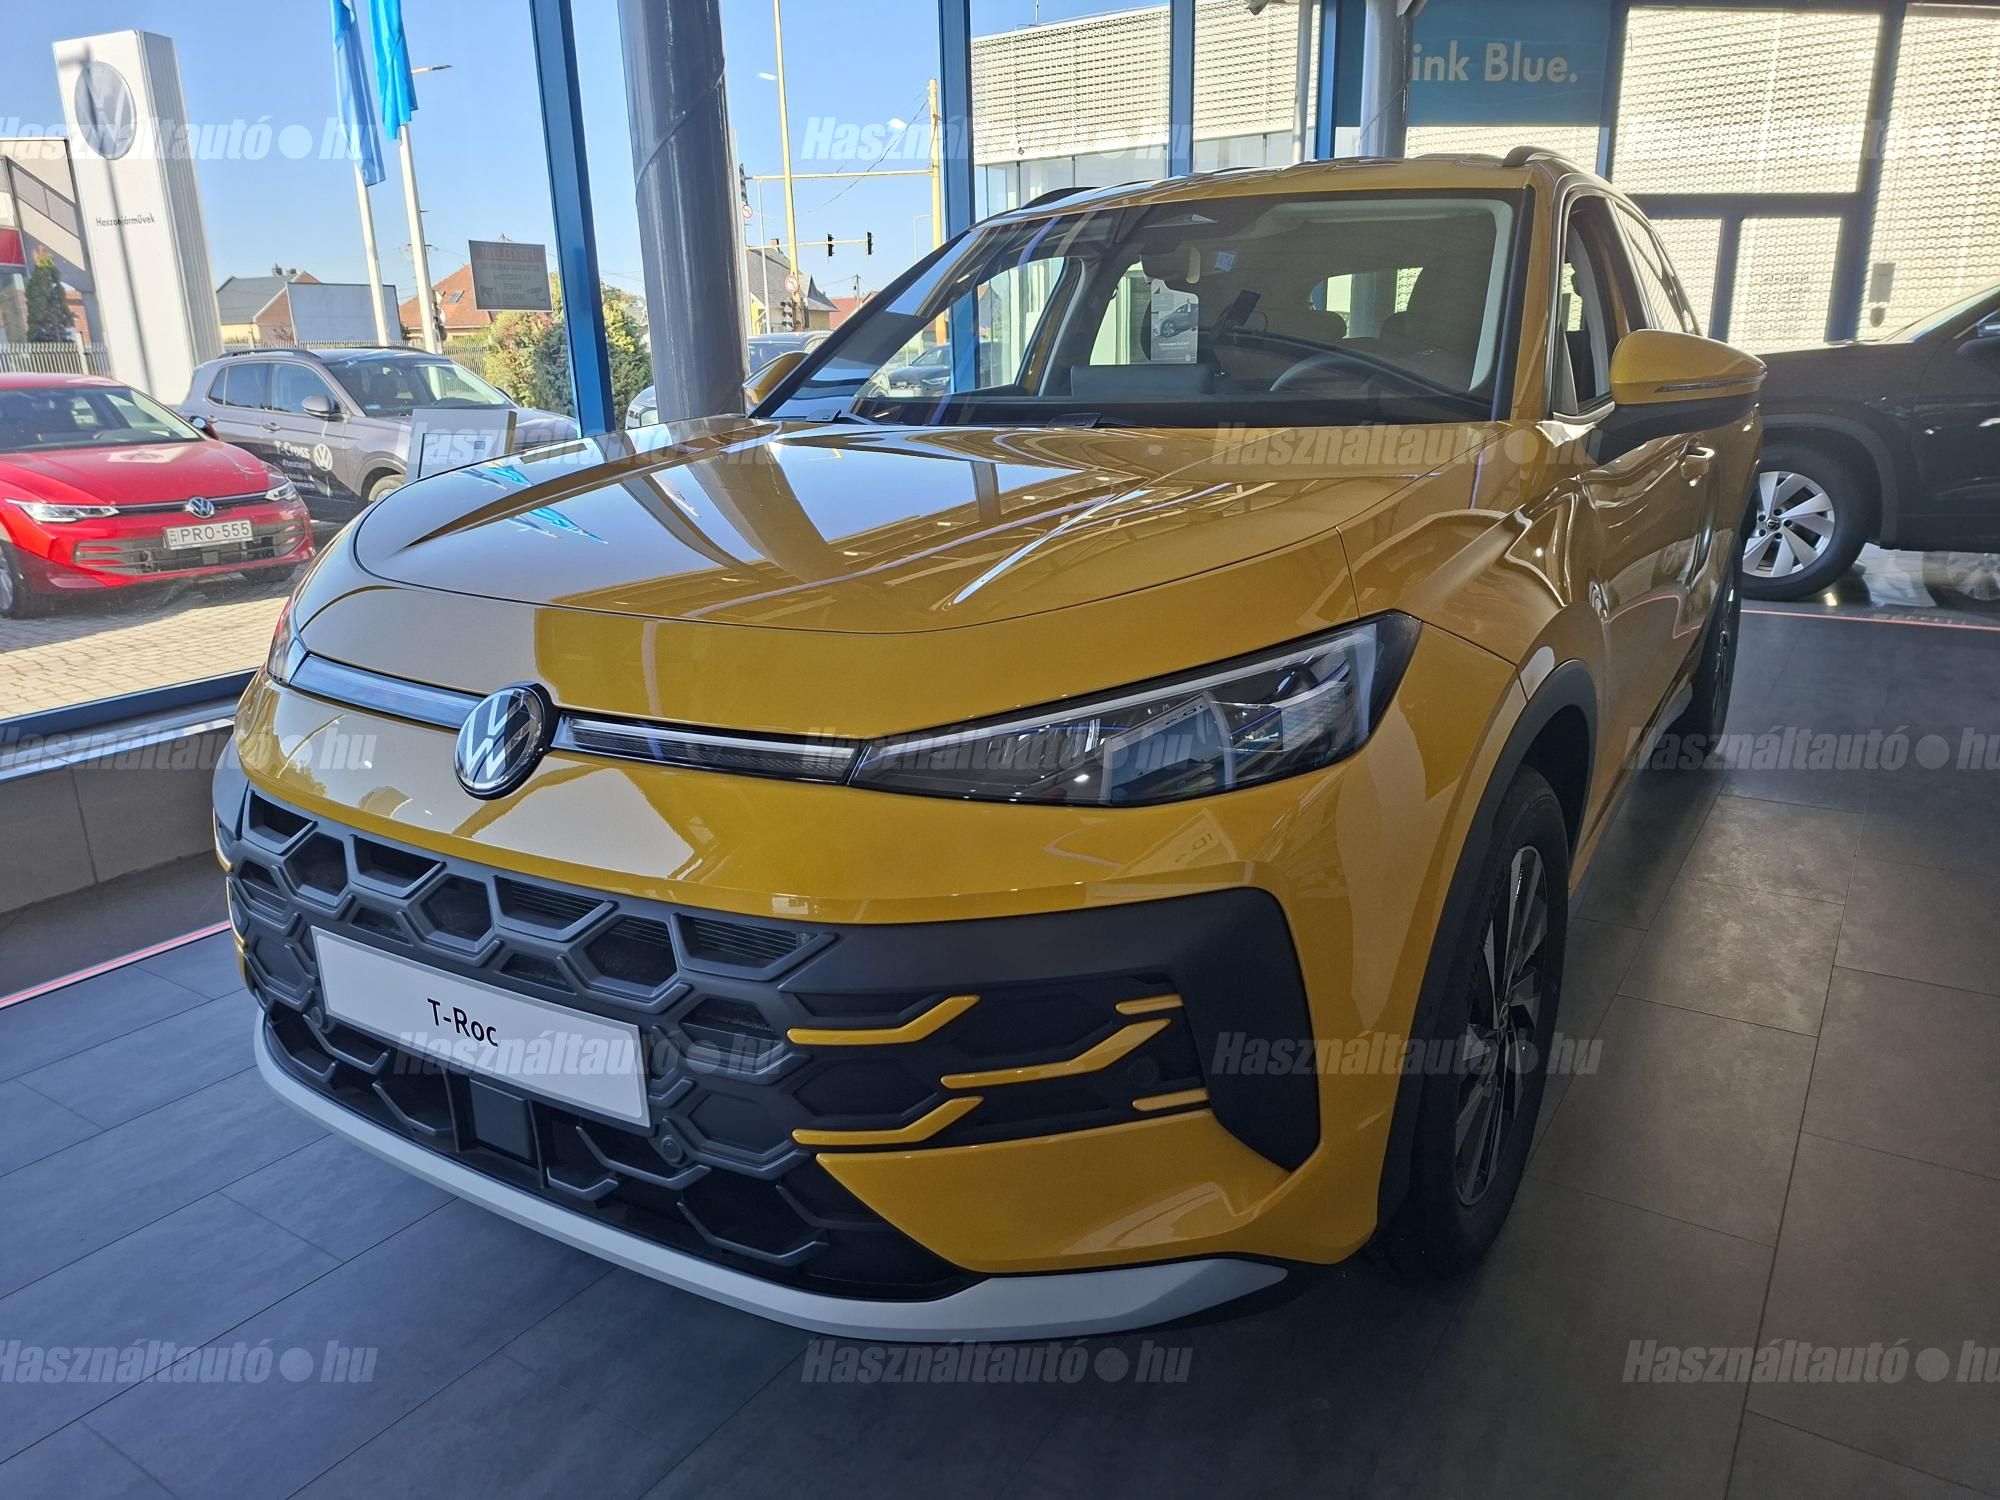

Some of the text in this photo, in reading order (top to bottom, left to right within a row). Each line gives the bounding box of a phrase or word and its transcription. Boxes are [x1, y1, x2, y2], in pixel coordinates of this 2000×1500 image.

[1484, 40, 1579, 82] Blue.
[274, 440, 311, 459] T-Cross
[180, 522, 250, 542] PRO-555
[427, 997, 499, 1048] T-Roc
